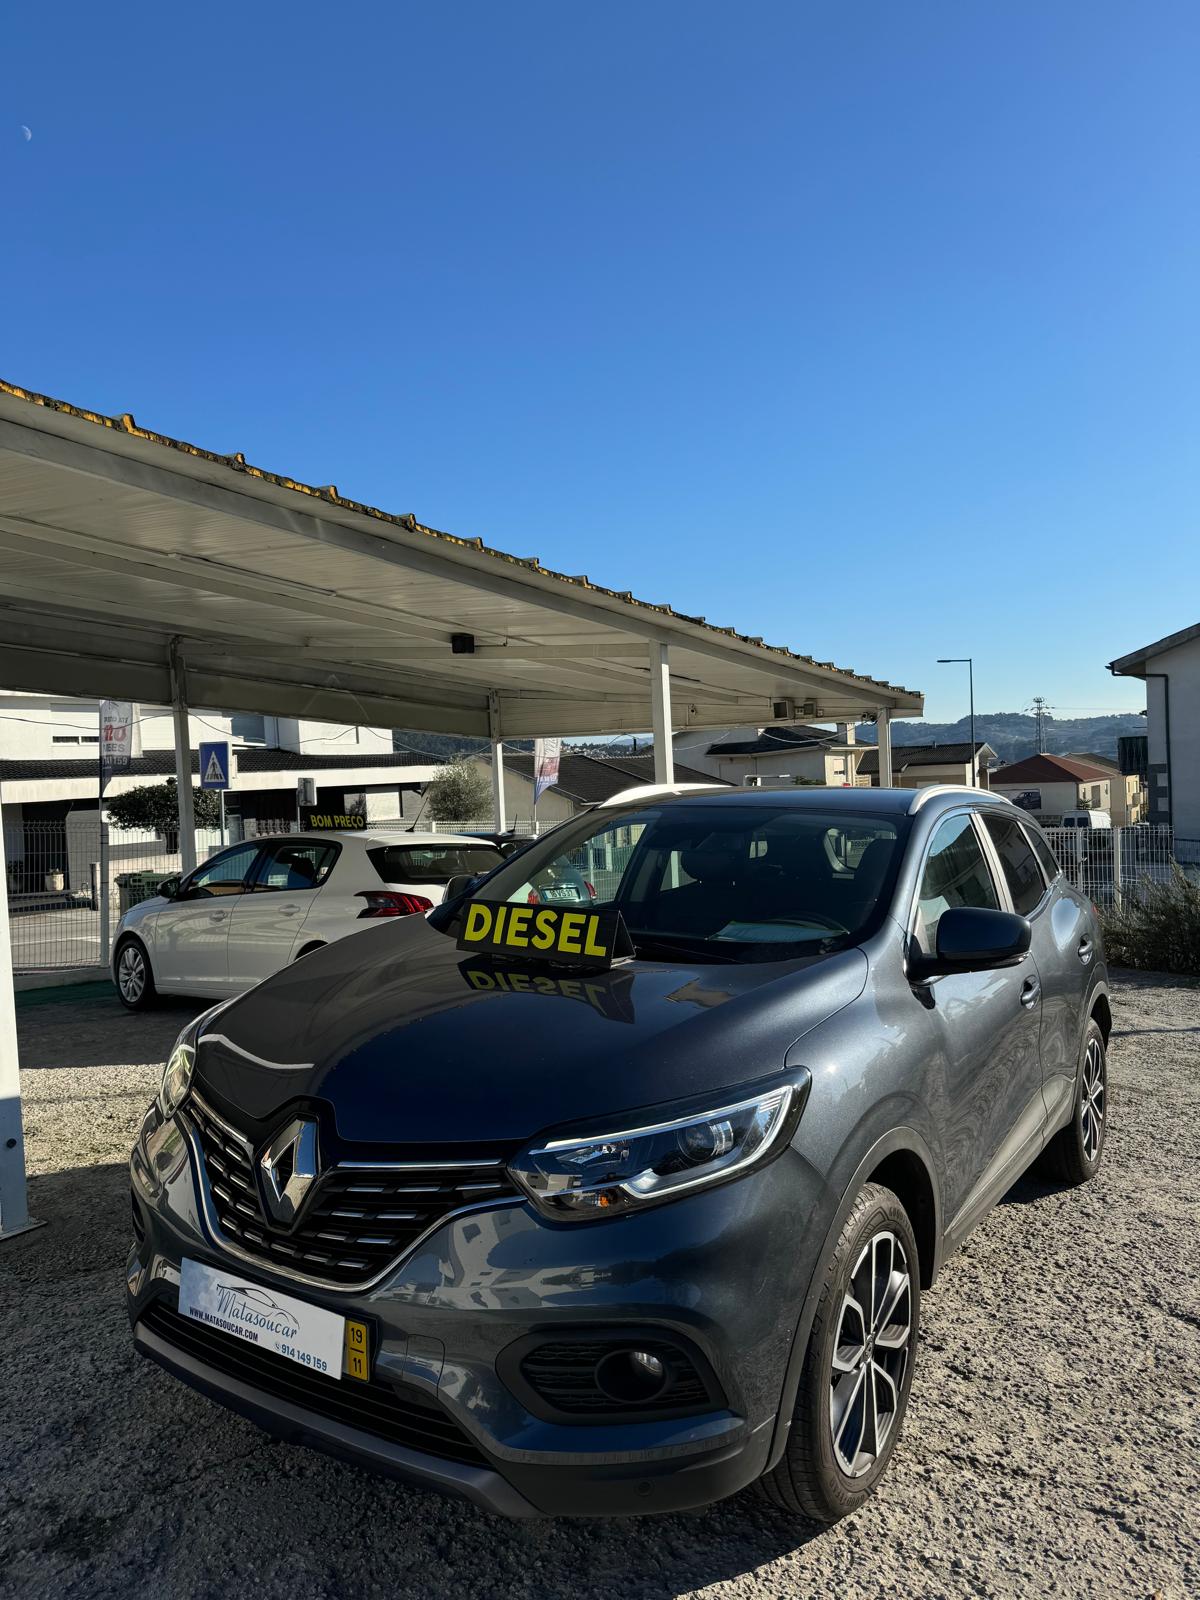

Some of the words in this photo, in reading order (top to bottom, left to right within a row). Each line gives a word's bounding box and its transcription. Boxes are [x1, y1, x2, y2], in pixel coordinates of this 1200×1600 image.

[310, 815, 334, 829] BOM
[335, 815, 364, 831] PREÇO
[464, 904, 606, 957] DIESEL
[189, 1306, 259, 1342] WWW.MATASOUCAR.COM
[216, 1286, 298, 1339] Matasoucar
[350, 1327, 363, 1344] 19
[281, 1344, 295, 1357] 914
[297, 1350, 312, 1365] 149
[312, 1356, 328, 1371] 159
[353, 1357, 363, 1374] 11
